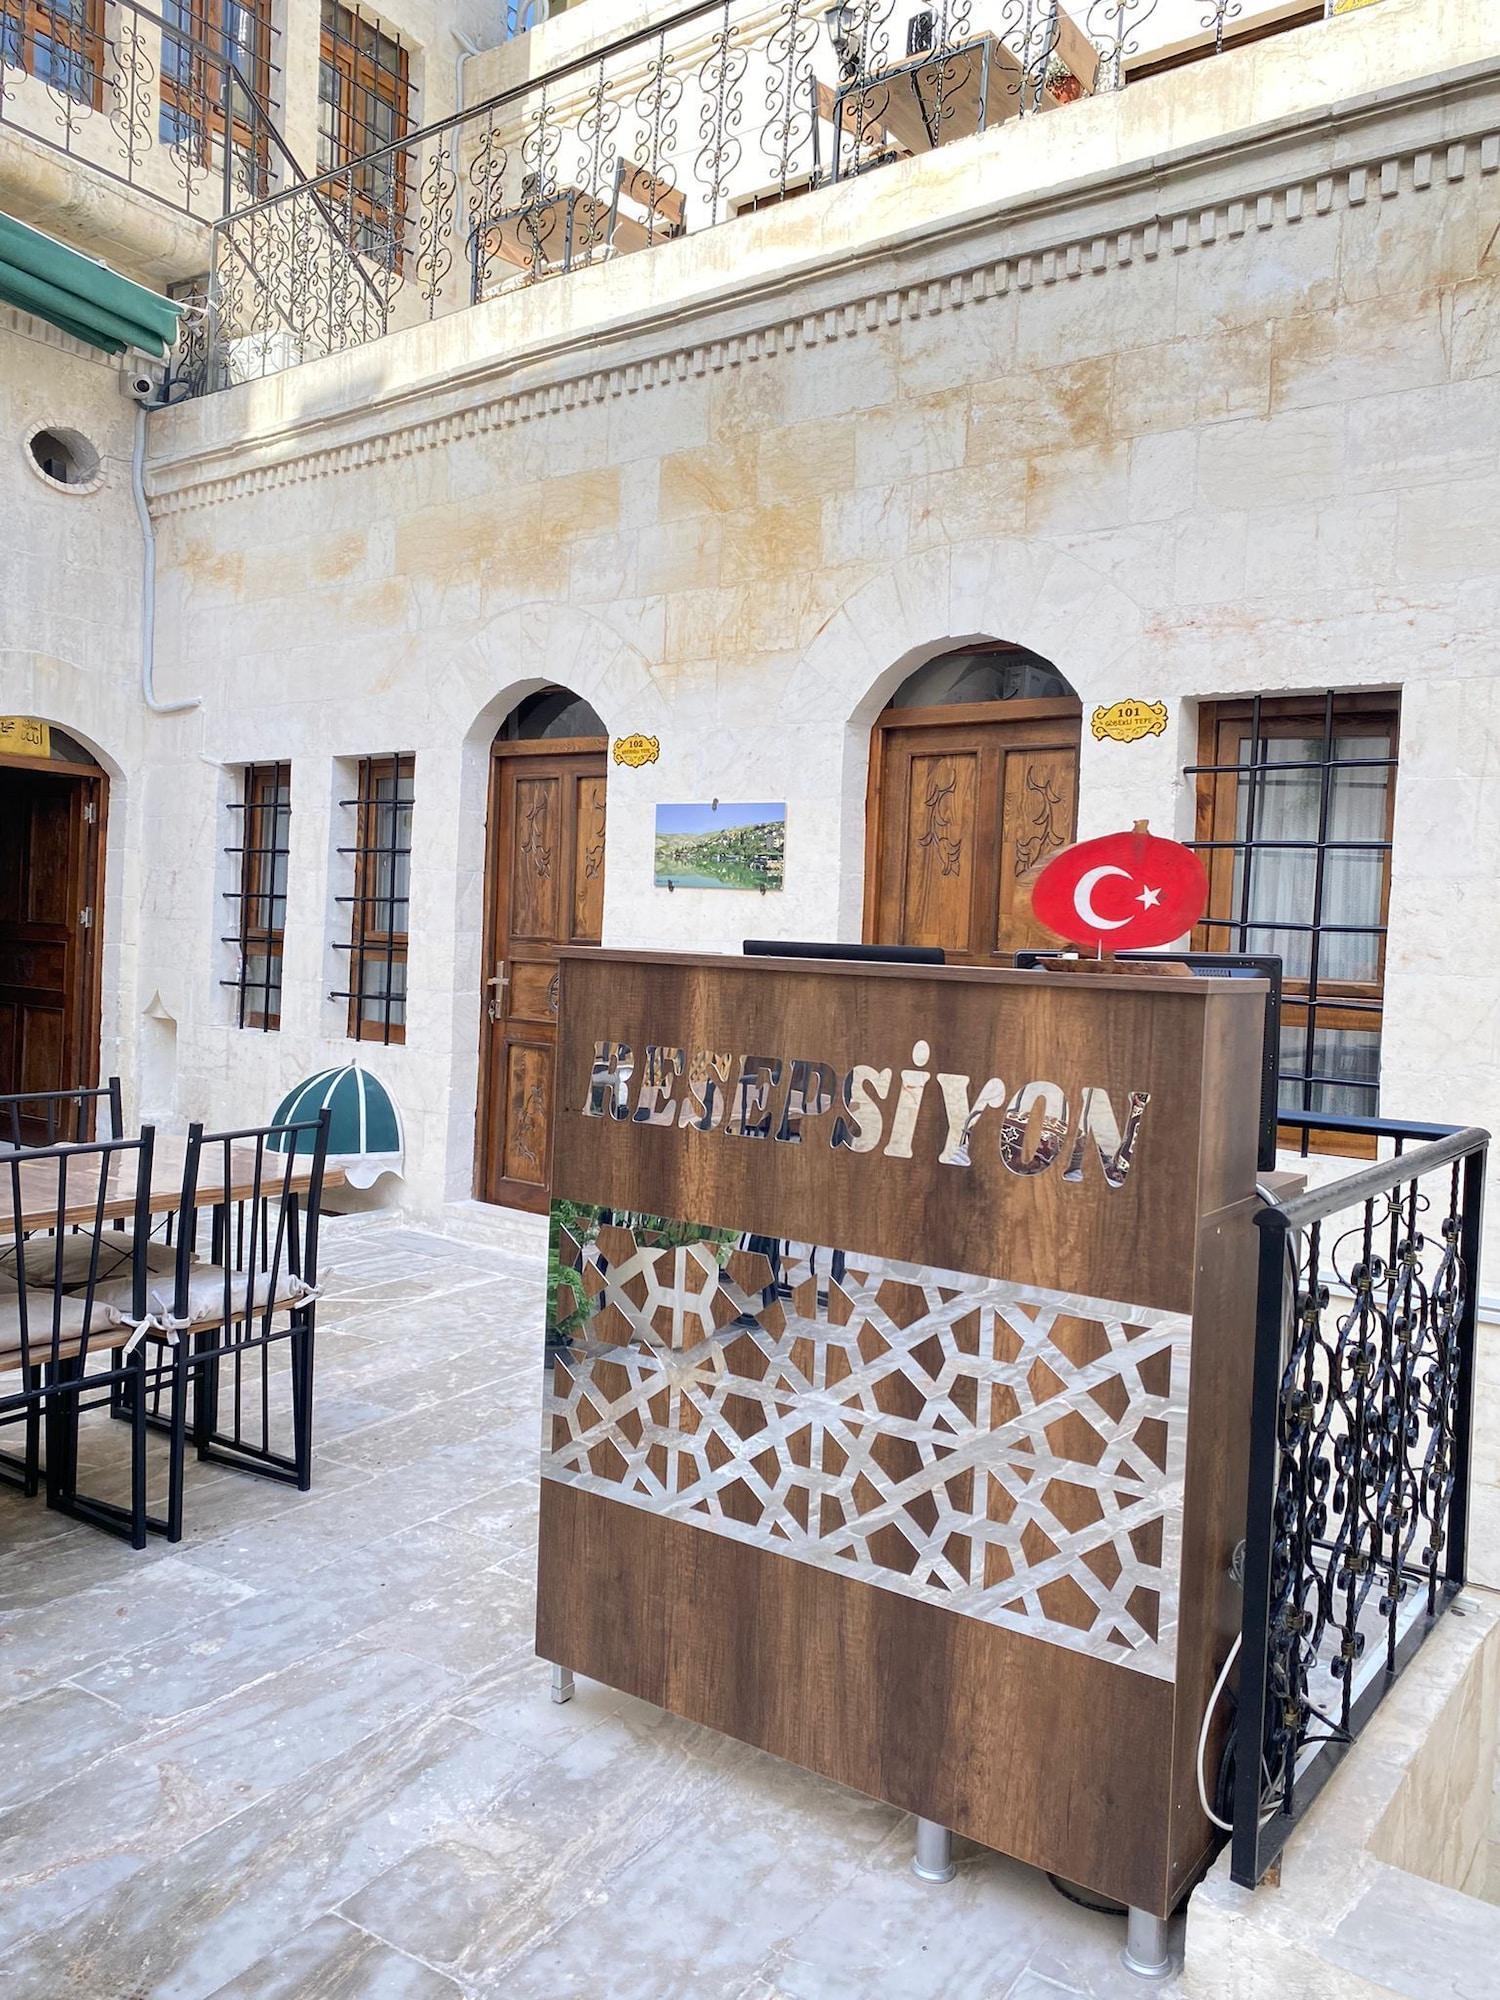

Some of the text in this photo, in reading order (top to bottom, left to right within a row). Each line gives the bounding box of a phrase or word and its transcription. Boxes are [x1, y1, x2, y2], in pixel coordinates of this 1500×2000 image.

[1117, 707, 1140, 718] 101
[629, 740, 644, 749] 102
[583, 1039, 1151, 1189] RESEPSİYON
